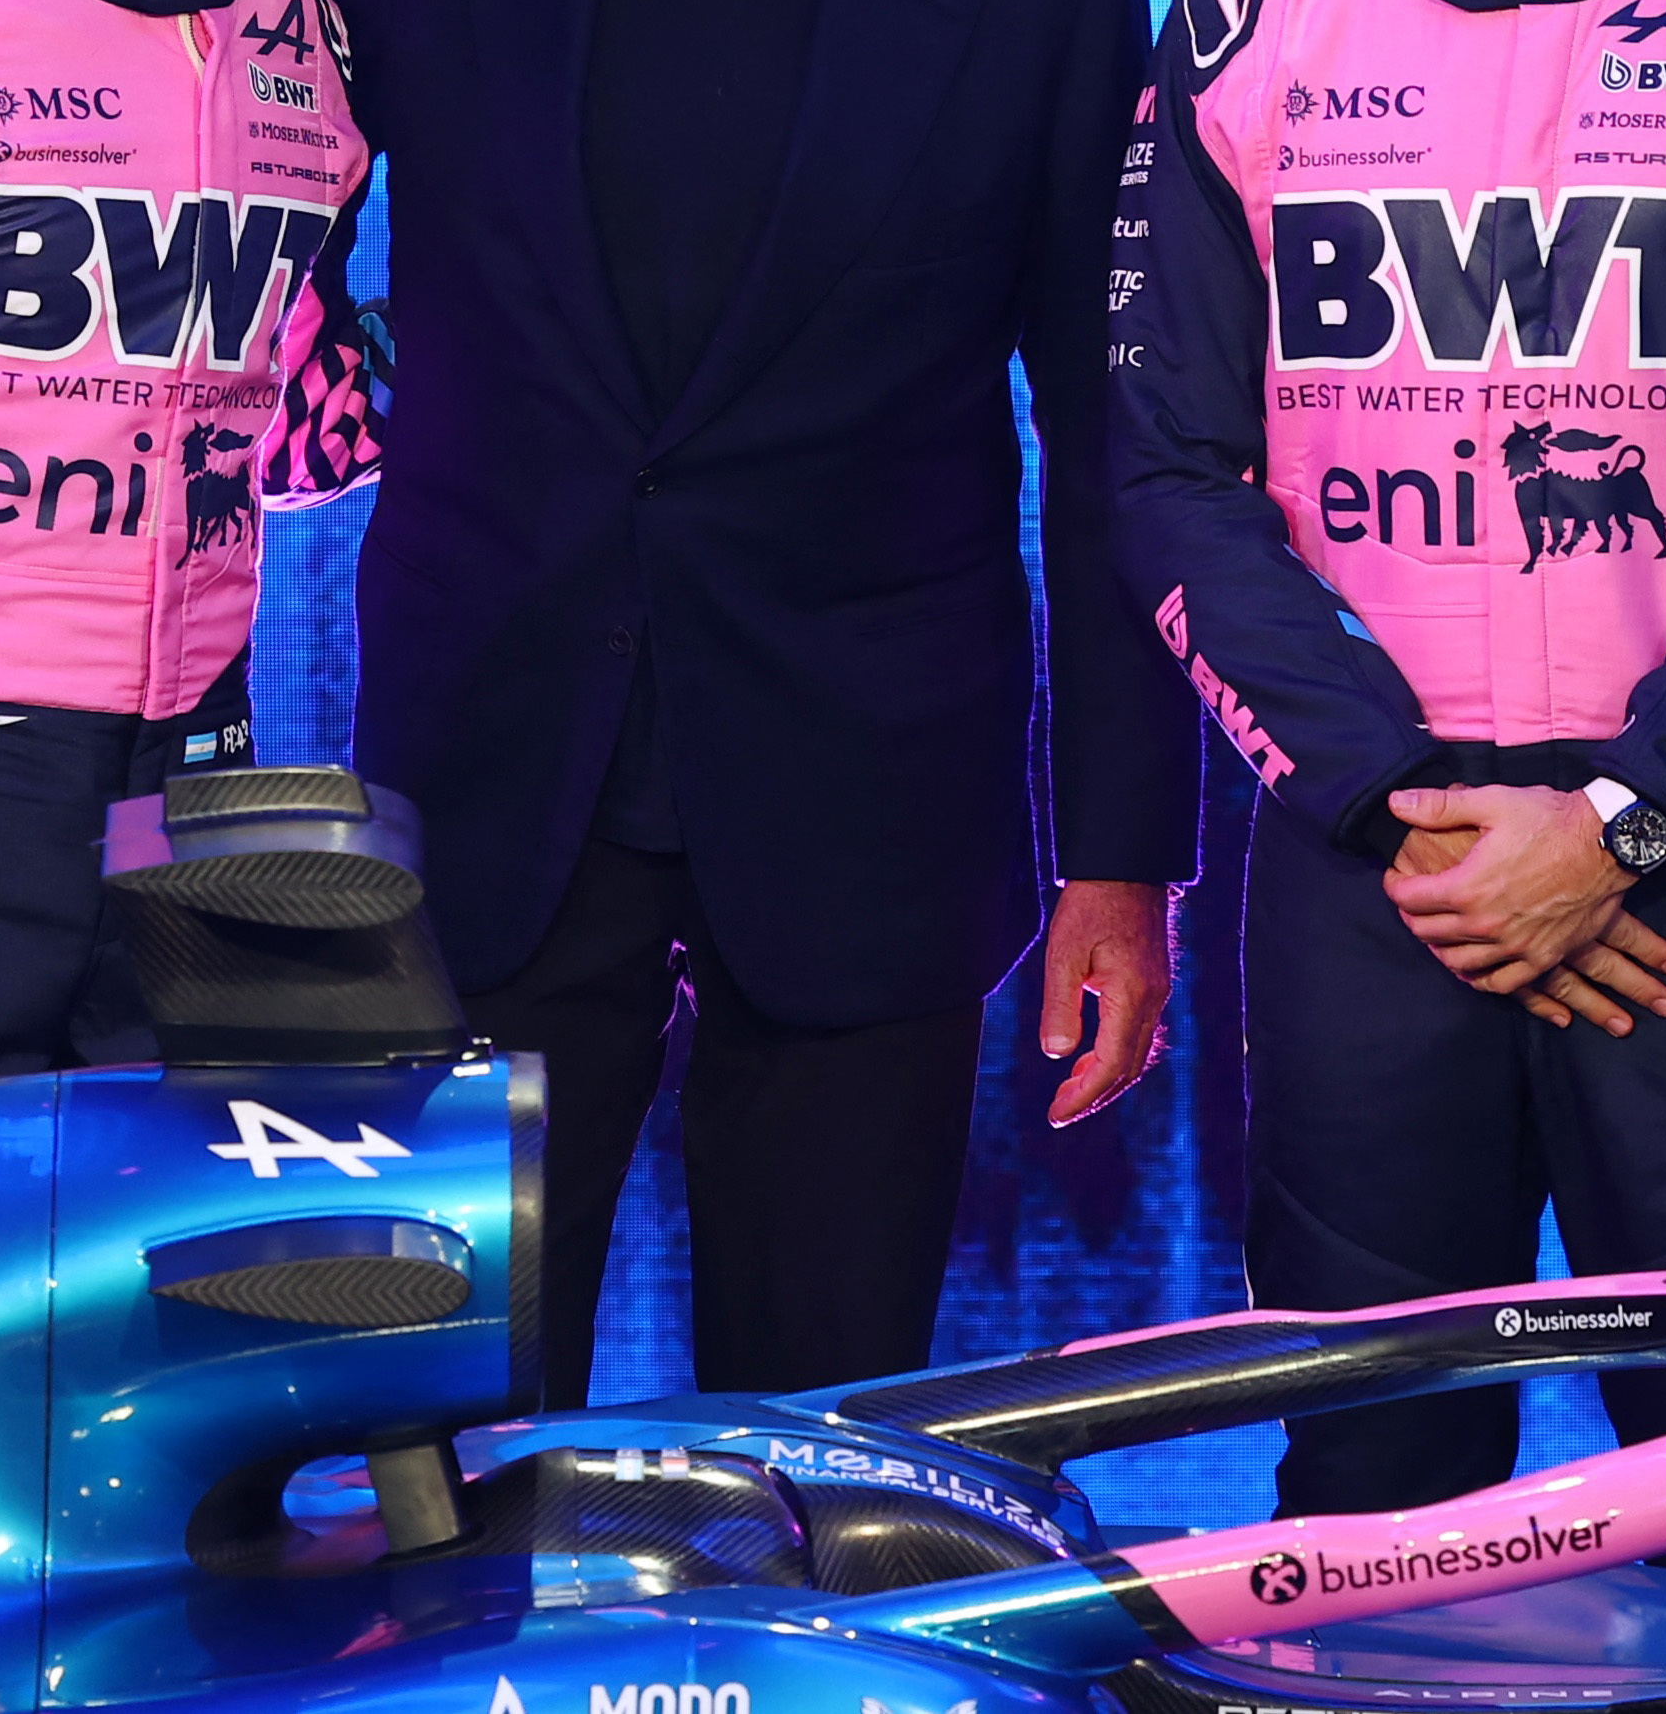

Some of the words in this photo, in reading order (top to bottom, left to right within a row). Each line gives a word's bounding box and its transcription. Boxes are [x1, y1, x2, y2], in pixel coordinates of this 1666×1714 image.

[24, 87, 122, 120] MSC
[271, 74, 320, 114] BWT
[1323, 86, 1425, 120] MSC
[14, 143, 131, 165] businessolver
[1299, 144, 1425, 167] businessolver
[36, 376, 153, 408] WATER
[1277, 385, 1346, 410] BEST
[1358, 385, 1463, 412] WATER
[1320, 439, 1476, 547] eni
[1525, 1304, 1653, 1332] businessolver
[1317, 1516, 1611, 1594] businessolver
